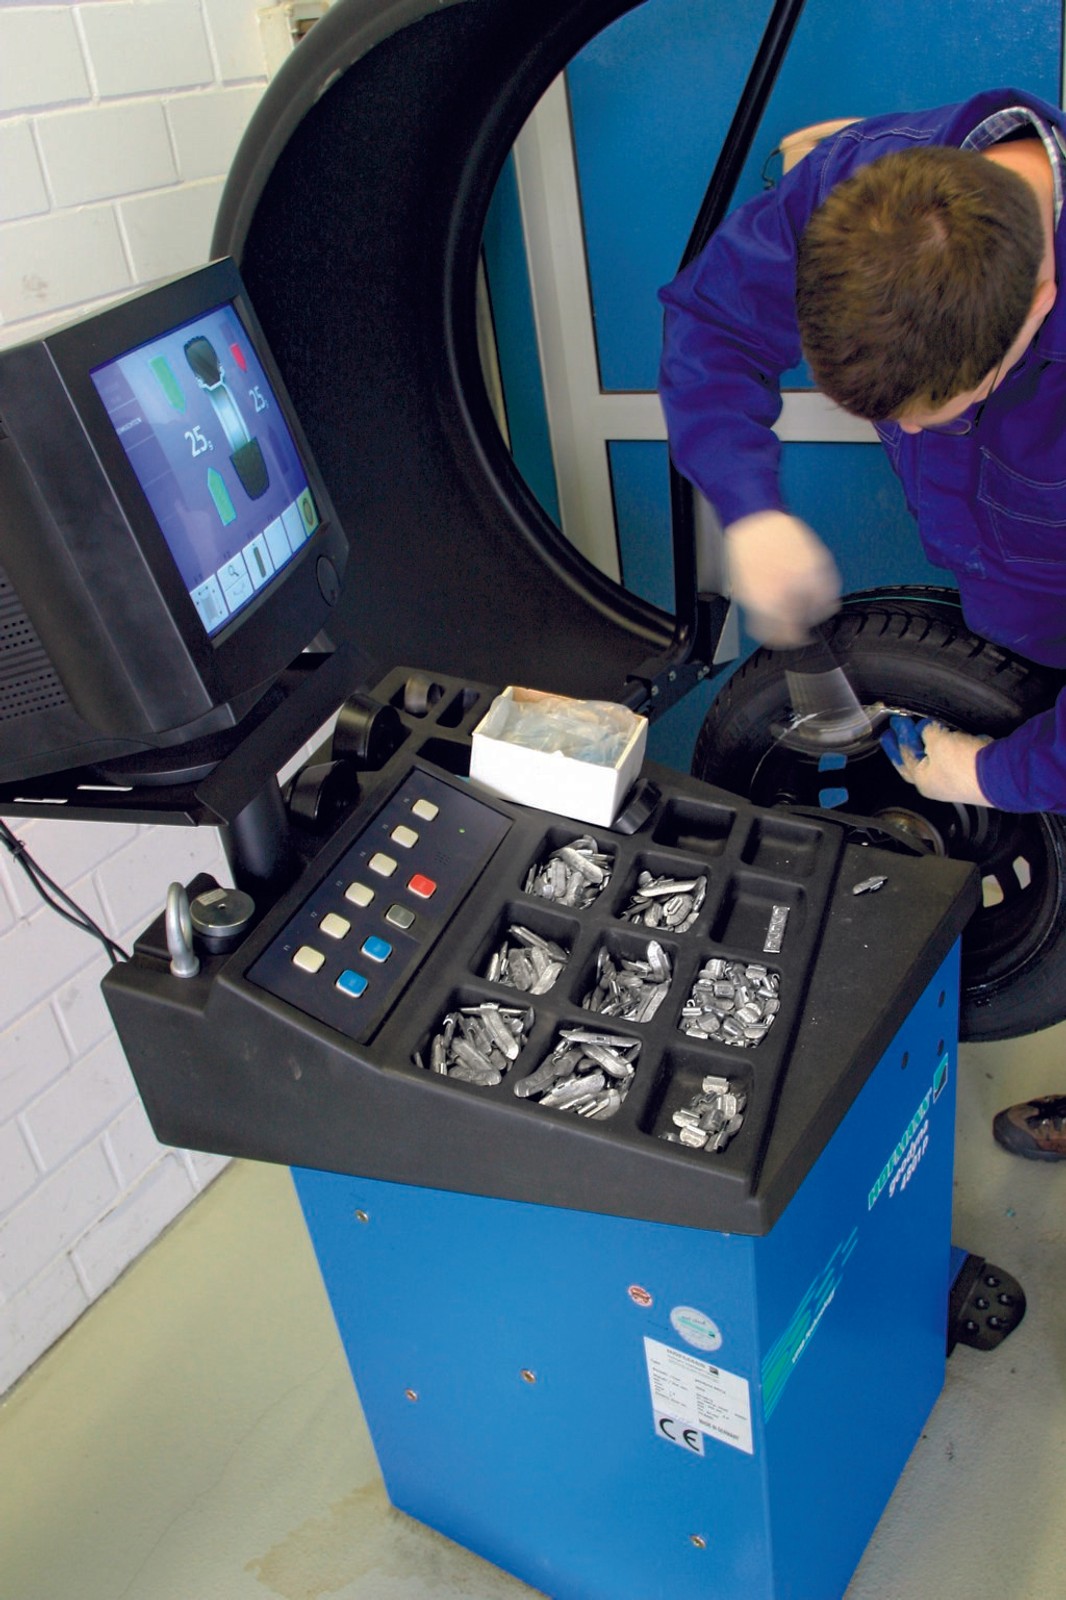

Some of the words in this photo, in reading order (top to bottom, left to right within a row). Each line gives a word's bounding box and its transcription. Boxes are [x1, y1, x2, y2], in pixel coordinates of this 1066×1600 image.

[249, 385, 266, 413] 25
[184, 425, 208, 457] 25
[659, 1418, 700, 1452] CE
